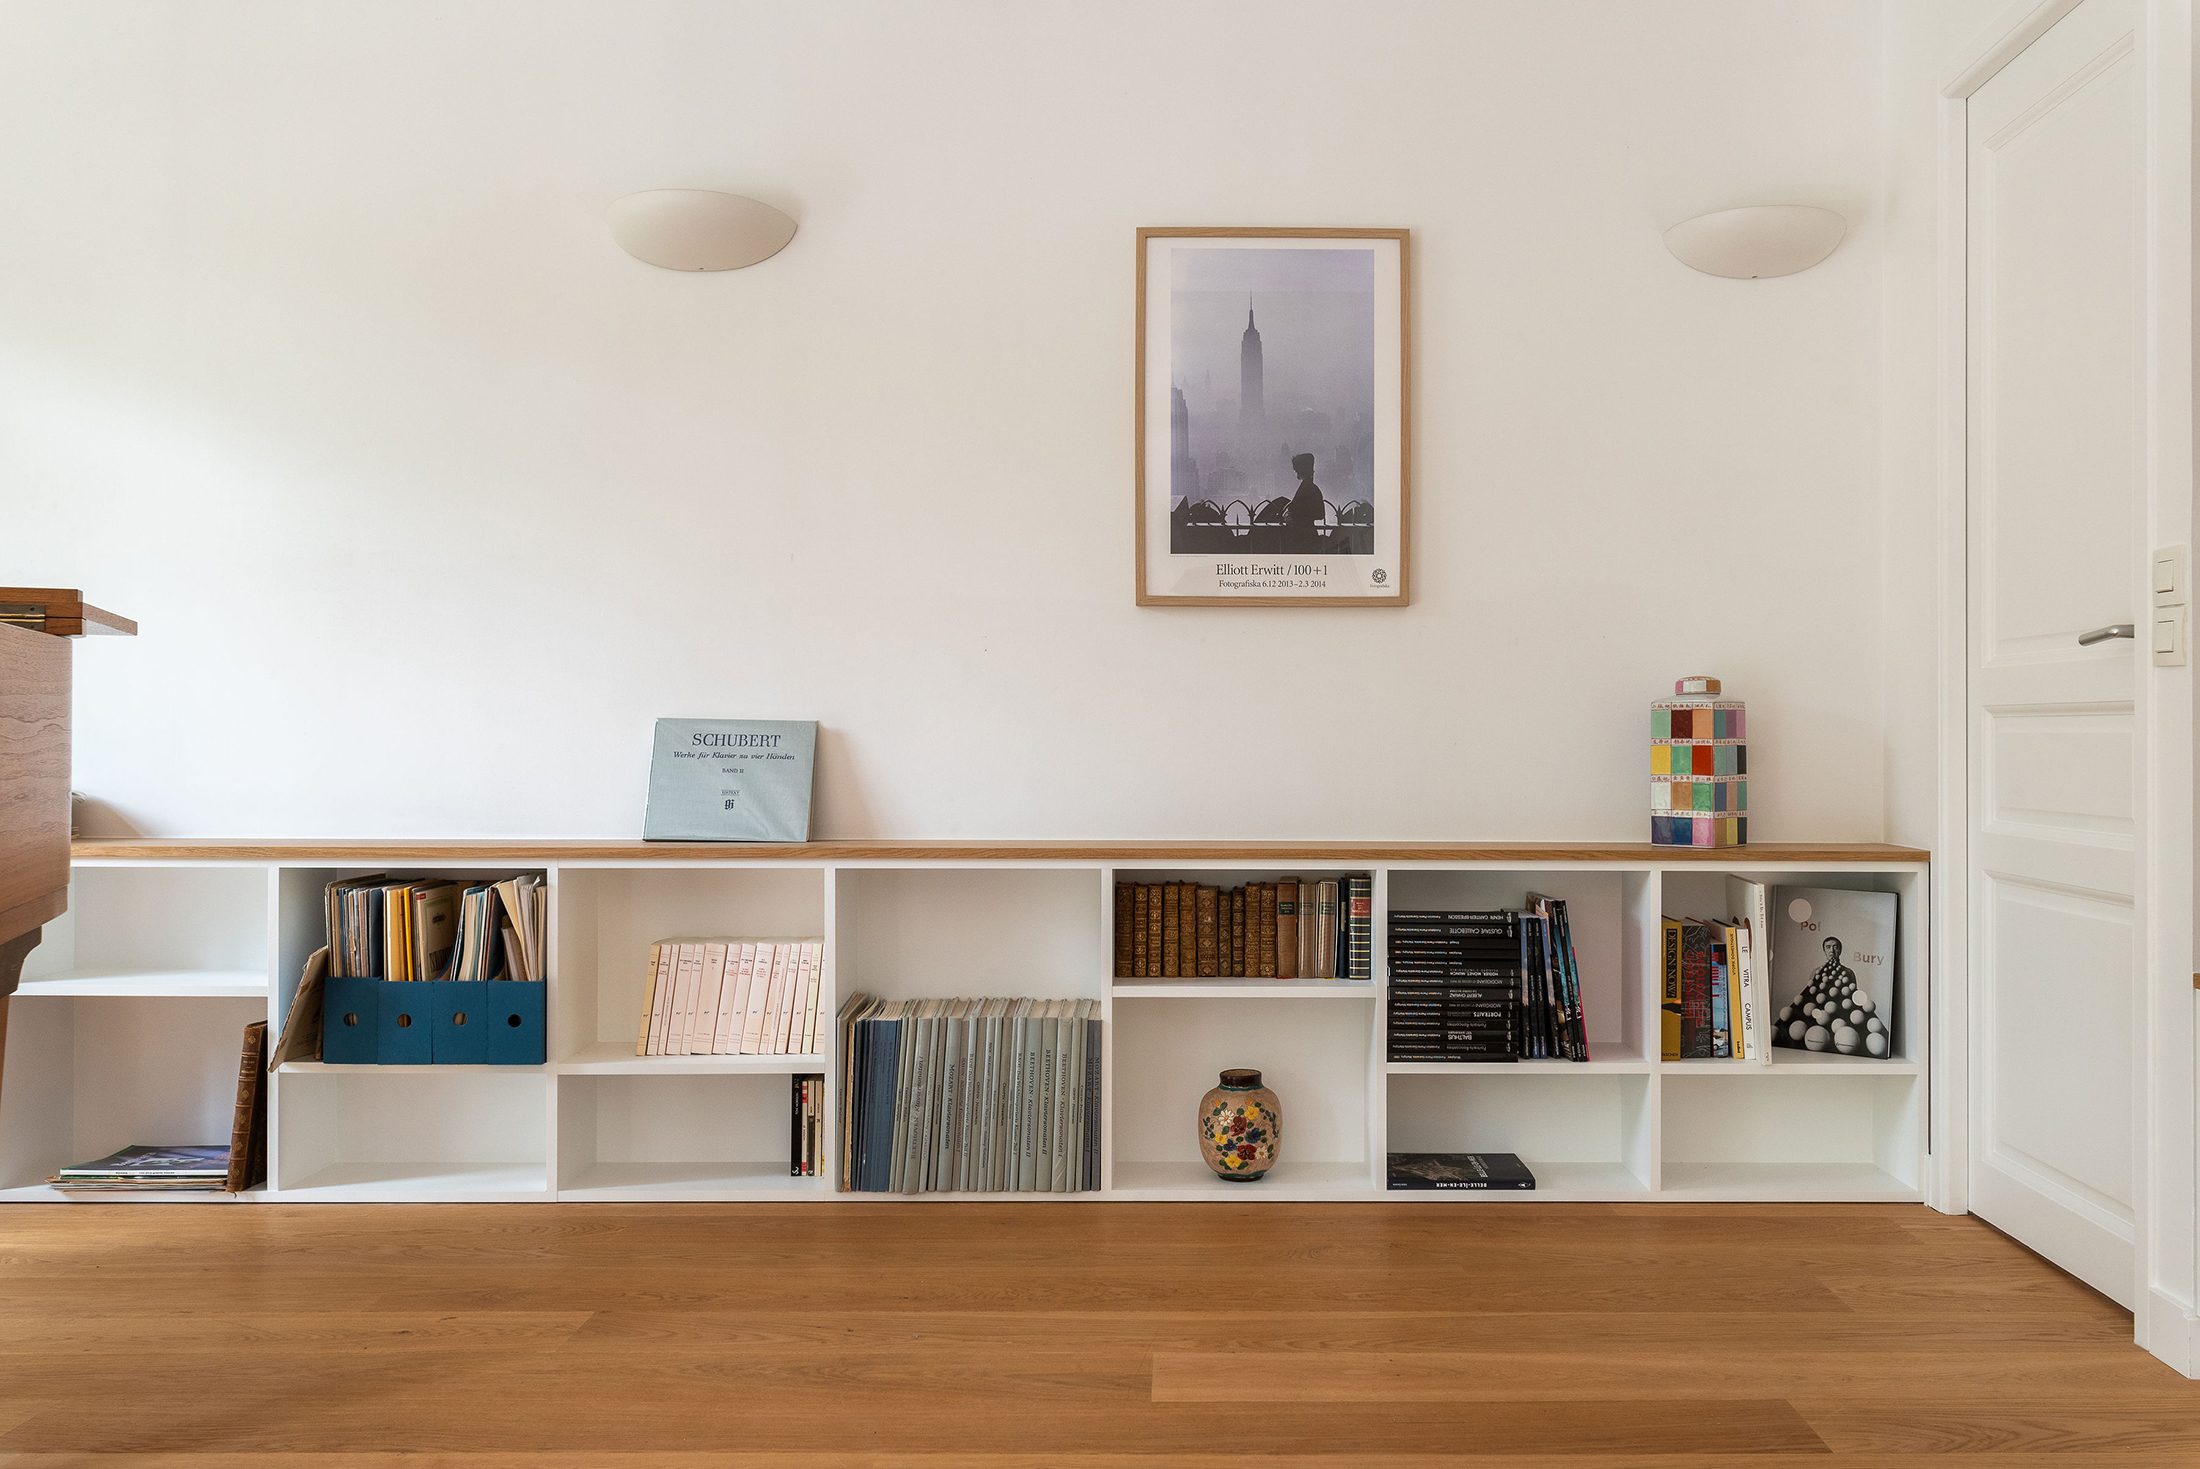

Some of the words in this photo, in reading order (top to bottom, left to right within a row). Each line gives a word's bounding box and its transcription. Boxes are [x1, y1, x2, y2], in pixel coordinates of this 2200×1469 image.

[1216, 564, 1248, 576] Elliott
[1251, 564, 1284, 576] Erwitt
[1219, 580, 1261, 588] Fotografiska
[1262, 580, 1276, 588] 6.12
[1310, 580, 1326, 588] 2014
[692, 733, 781, 748] SCHUBERT
[1668, 930, 1677, 966] DESIGN
[1854, 952, 1885, 965] Bury
[1668, 968, 1676, 998] NOW!
[946, 1064, 955, 1093] MOZART
[943, 1097, 953, 1149] Klaviersonaten
